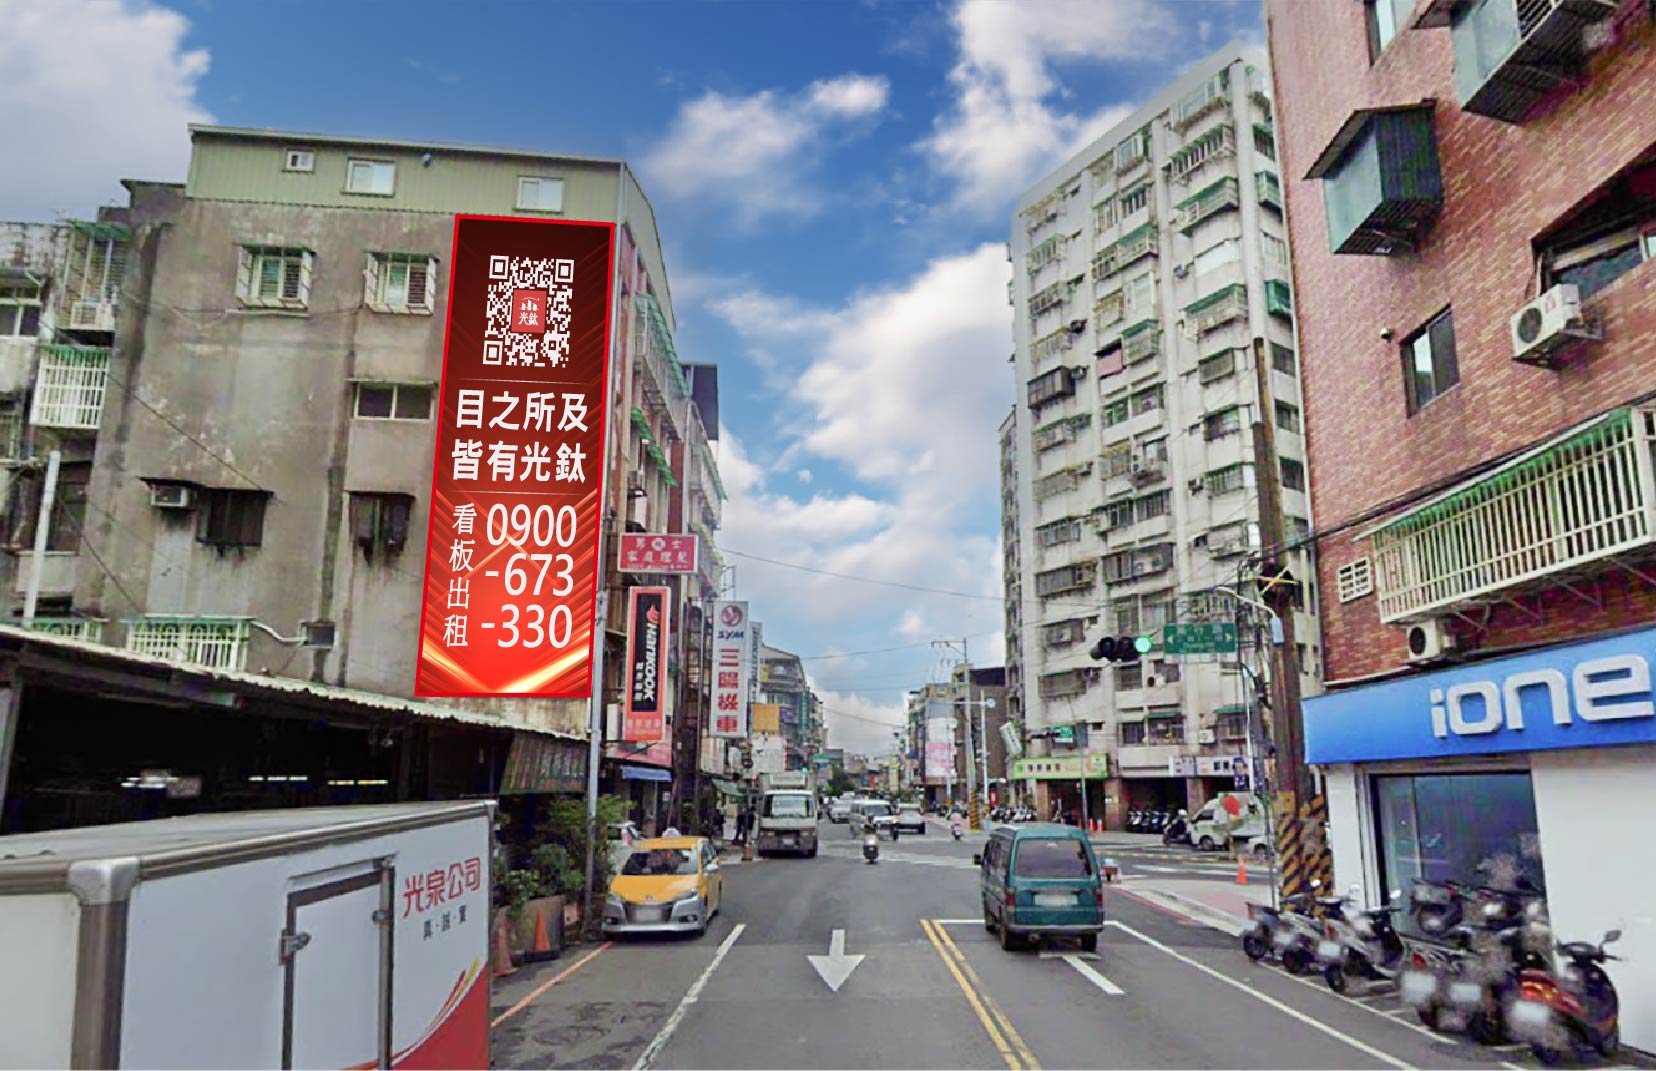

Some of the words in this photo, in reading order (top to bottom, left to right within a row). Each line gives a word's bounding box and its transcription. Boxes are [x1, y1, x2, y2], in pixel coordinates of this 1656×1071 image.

[518, 312, 539, 326] 光鈦
[456, 389, 589, 432] 目之所及
[451, 439, 587, 484] 皆有光鈦
[486, 503, 577, 547] 0900
[443, 503, 478, 648] 看板出租
[485, 553, 574, 596] -673
[481, 604, 573, 648] -330
[717, 631, 744, 640] SYM
[1429, 654, 1654, 738] ione
[402, 856, 481, 920] 光泉公司
